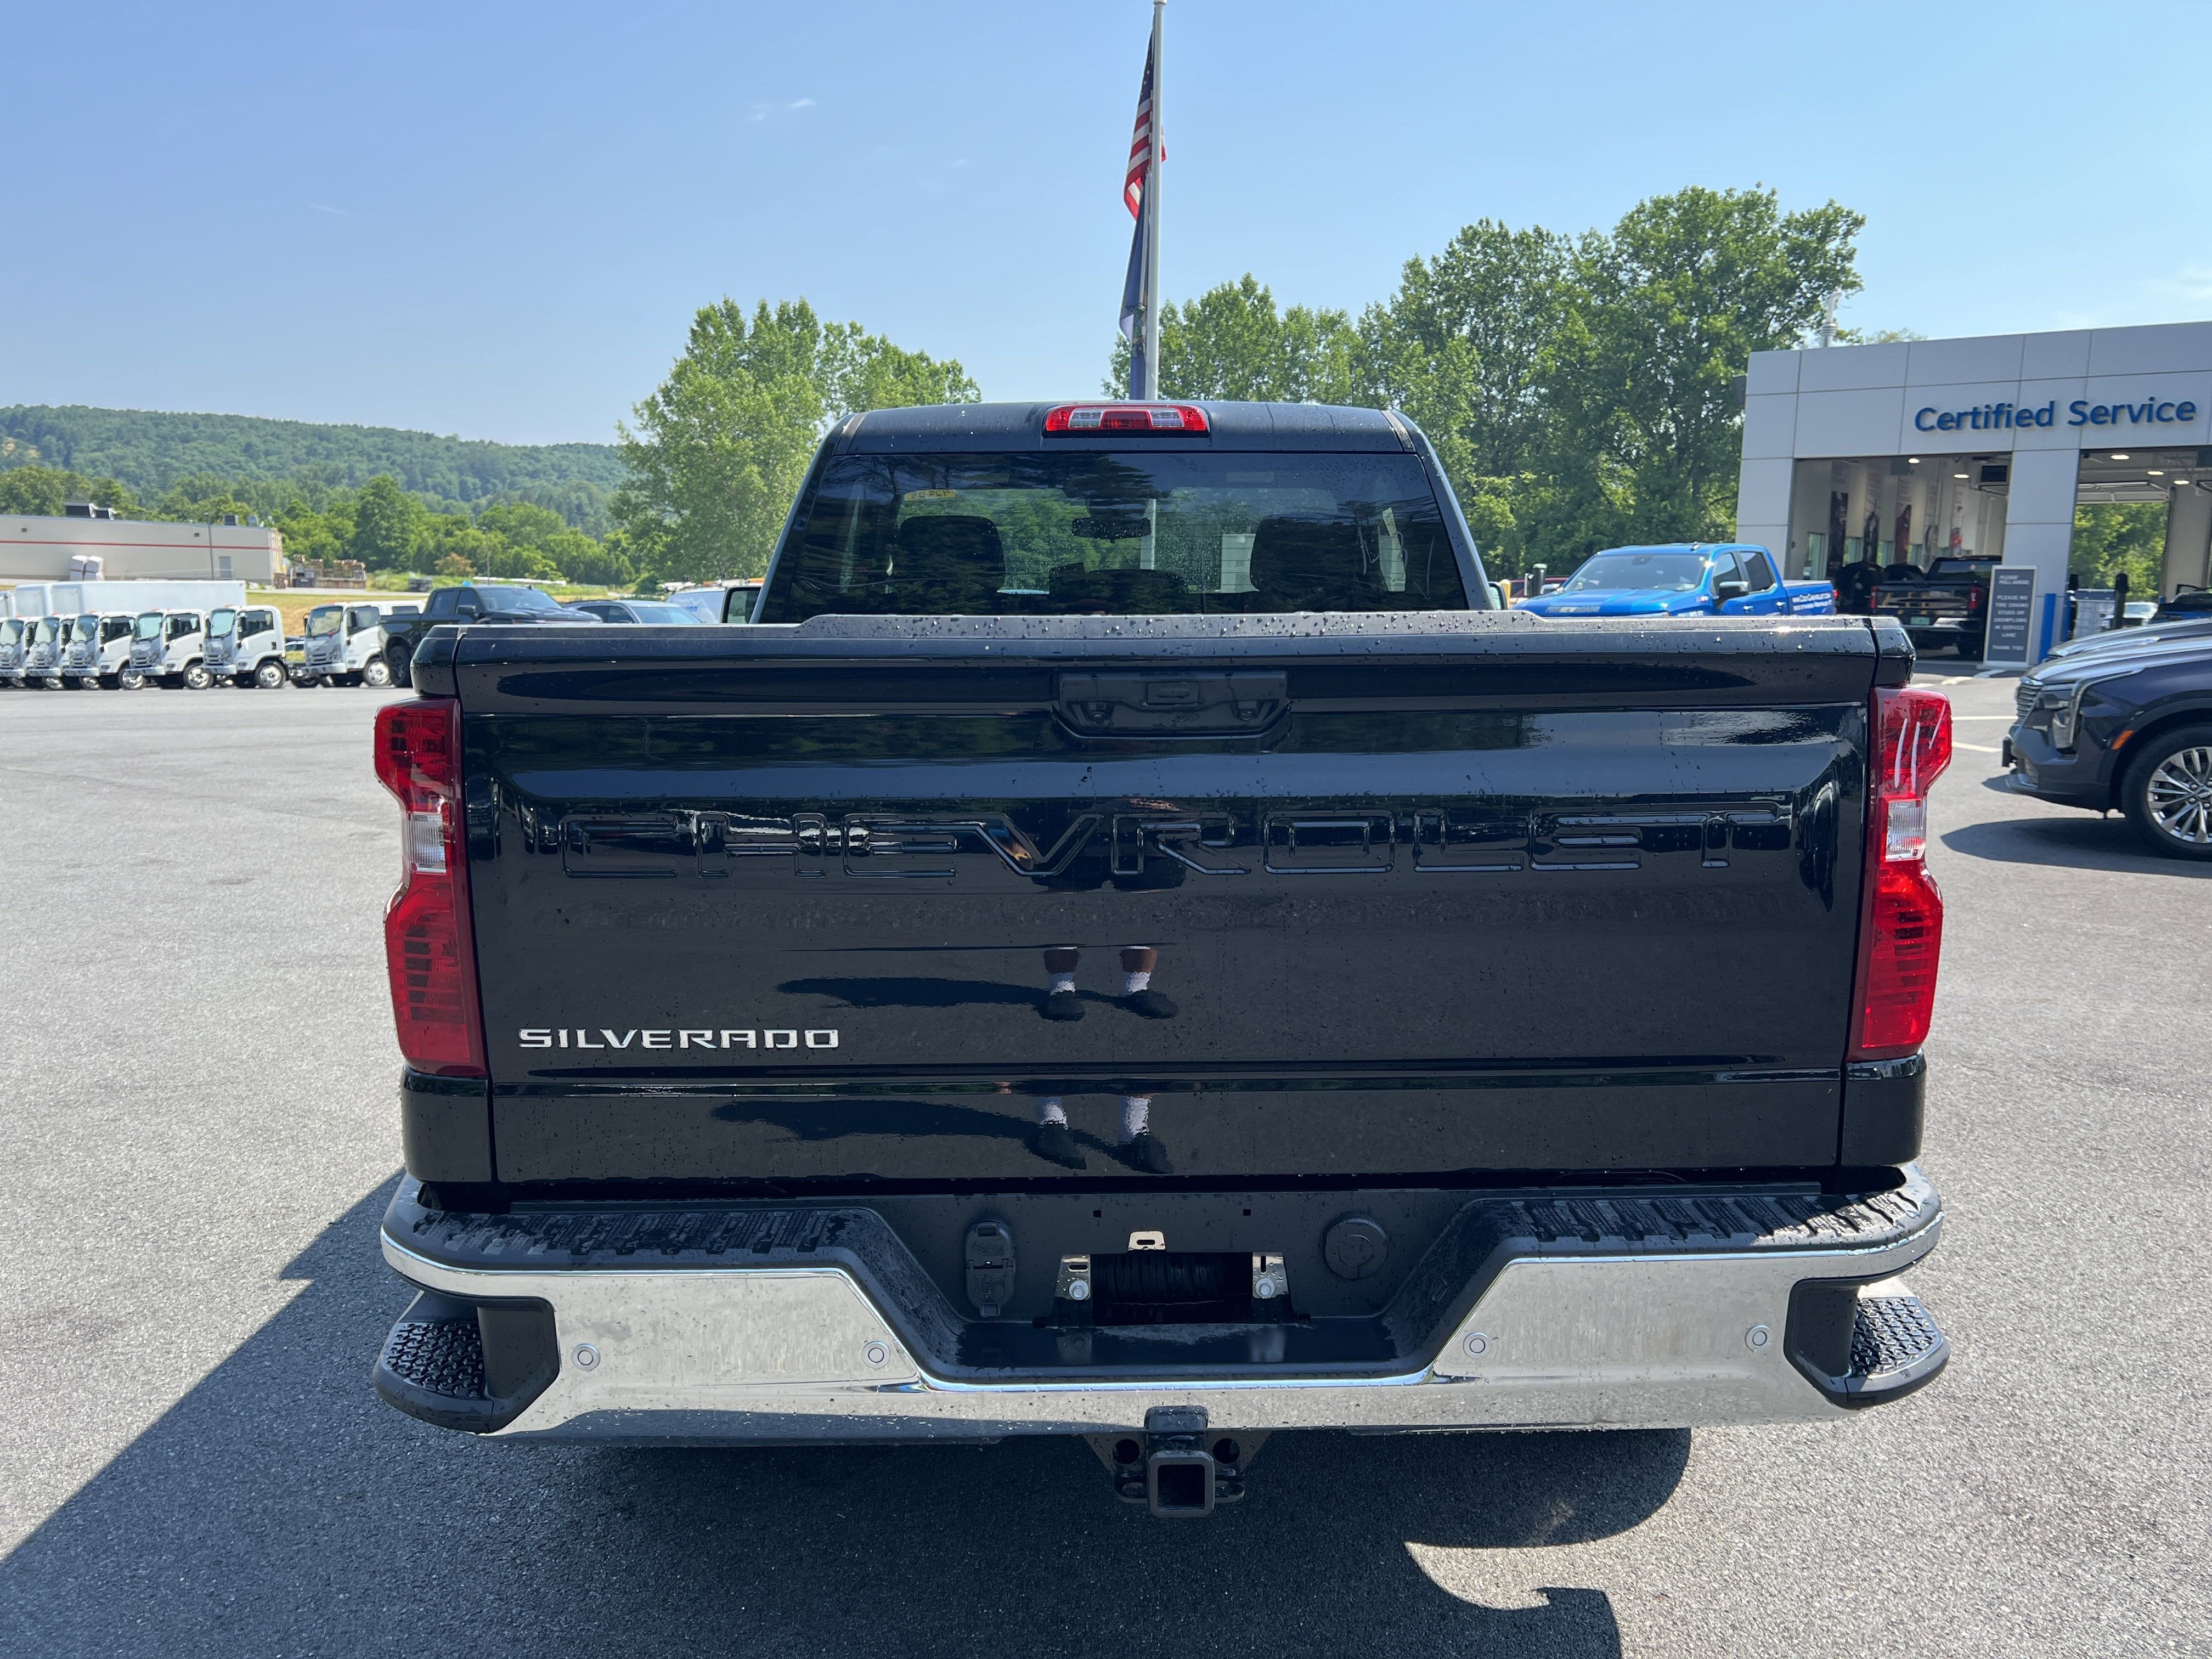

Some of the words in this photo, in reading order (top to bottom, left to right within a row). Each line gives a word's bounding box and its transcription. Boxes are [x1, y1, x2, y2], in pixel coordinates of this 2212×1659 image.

[1915, 400, 2055, 432] Certified
[2067, 396, 2196, 426] Service
[556, 802, 1779, 879] CHEVROLET
[518, 1028, 839, 1049] SILVERADO
